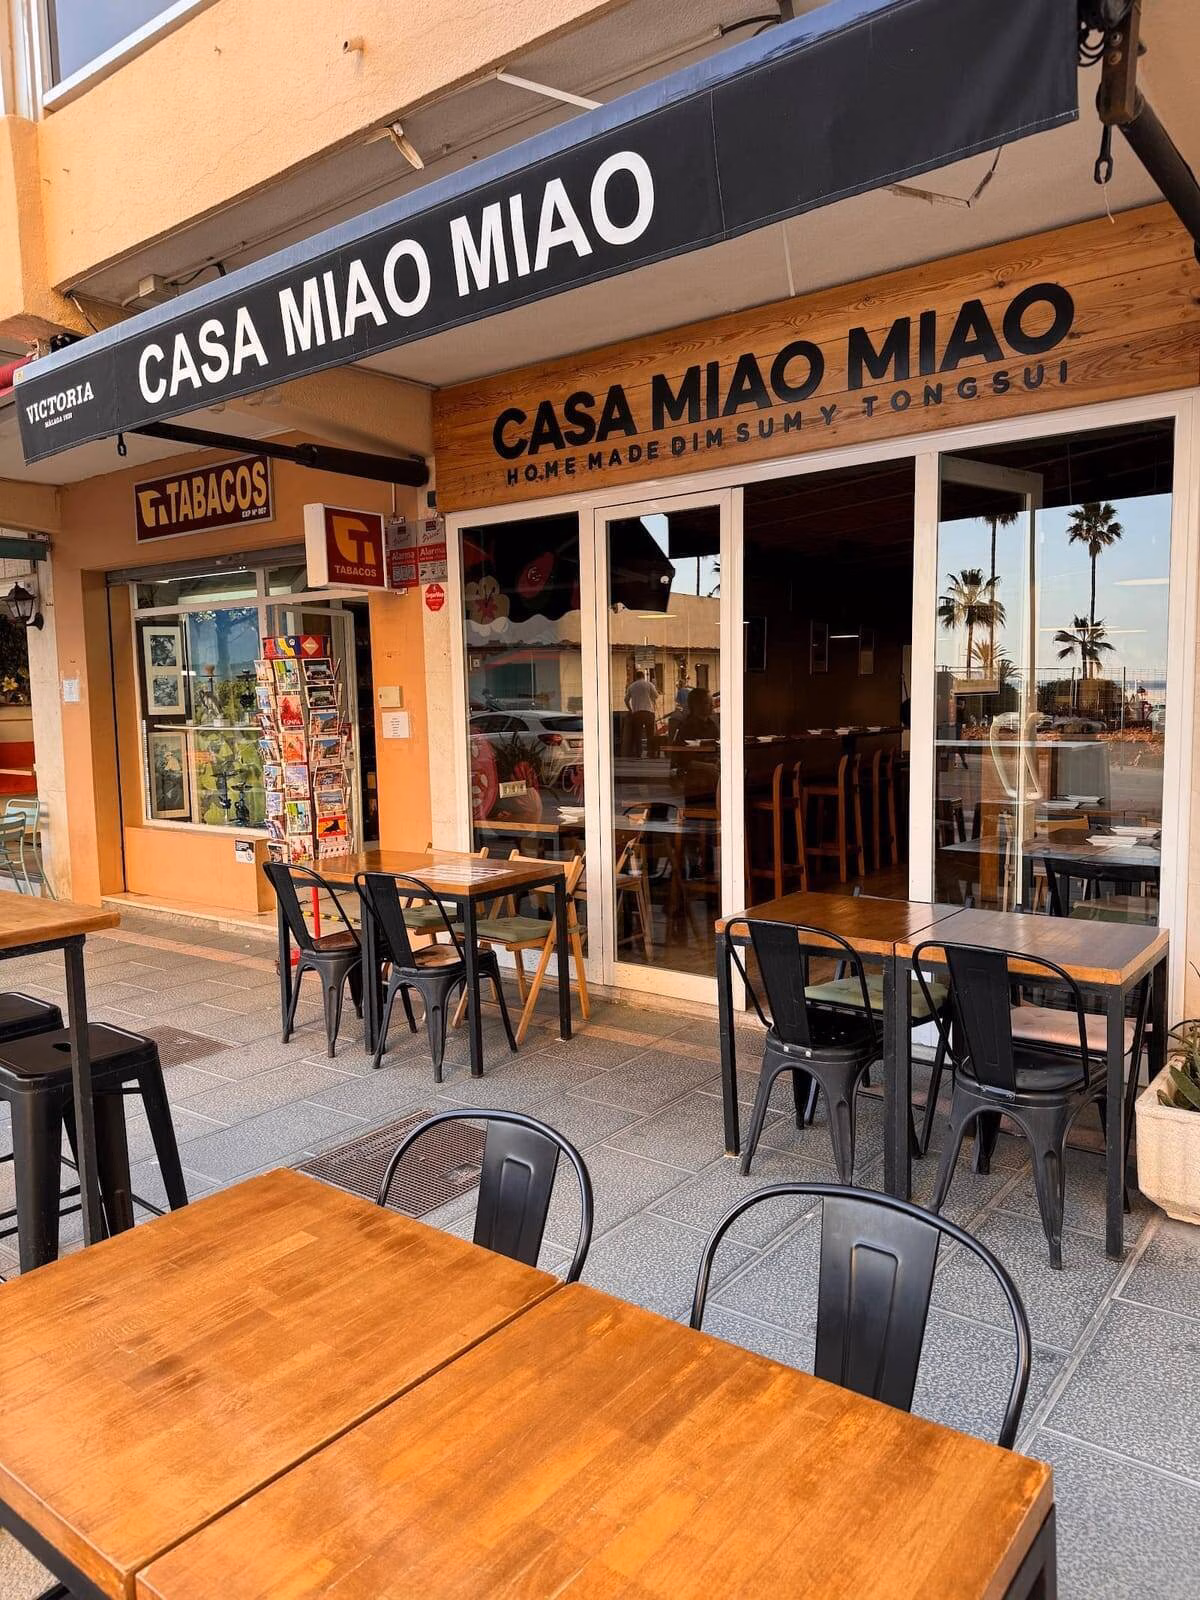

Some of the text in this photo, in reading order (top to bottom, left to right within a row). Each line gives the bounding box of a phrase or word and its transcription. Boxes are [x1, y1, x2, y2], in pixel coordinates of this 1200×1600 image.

[138, 150, 655, 404] CASA MIAO MIAO
[26, 381, 95, 425] VICTORIA
[492, 282, 1075, 460] CASA MIAO MIAO
[506, 359, 1068, 485] HOME MADE DIM SUM Y TONGSUI
[166, 461, 267, 523] TABACOS
[334, 565, 377, 577] TABACOS
